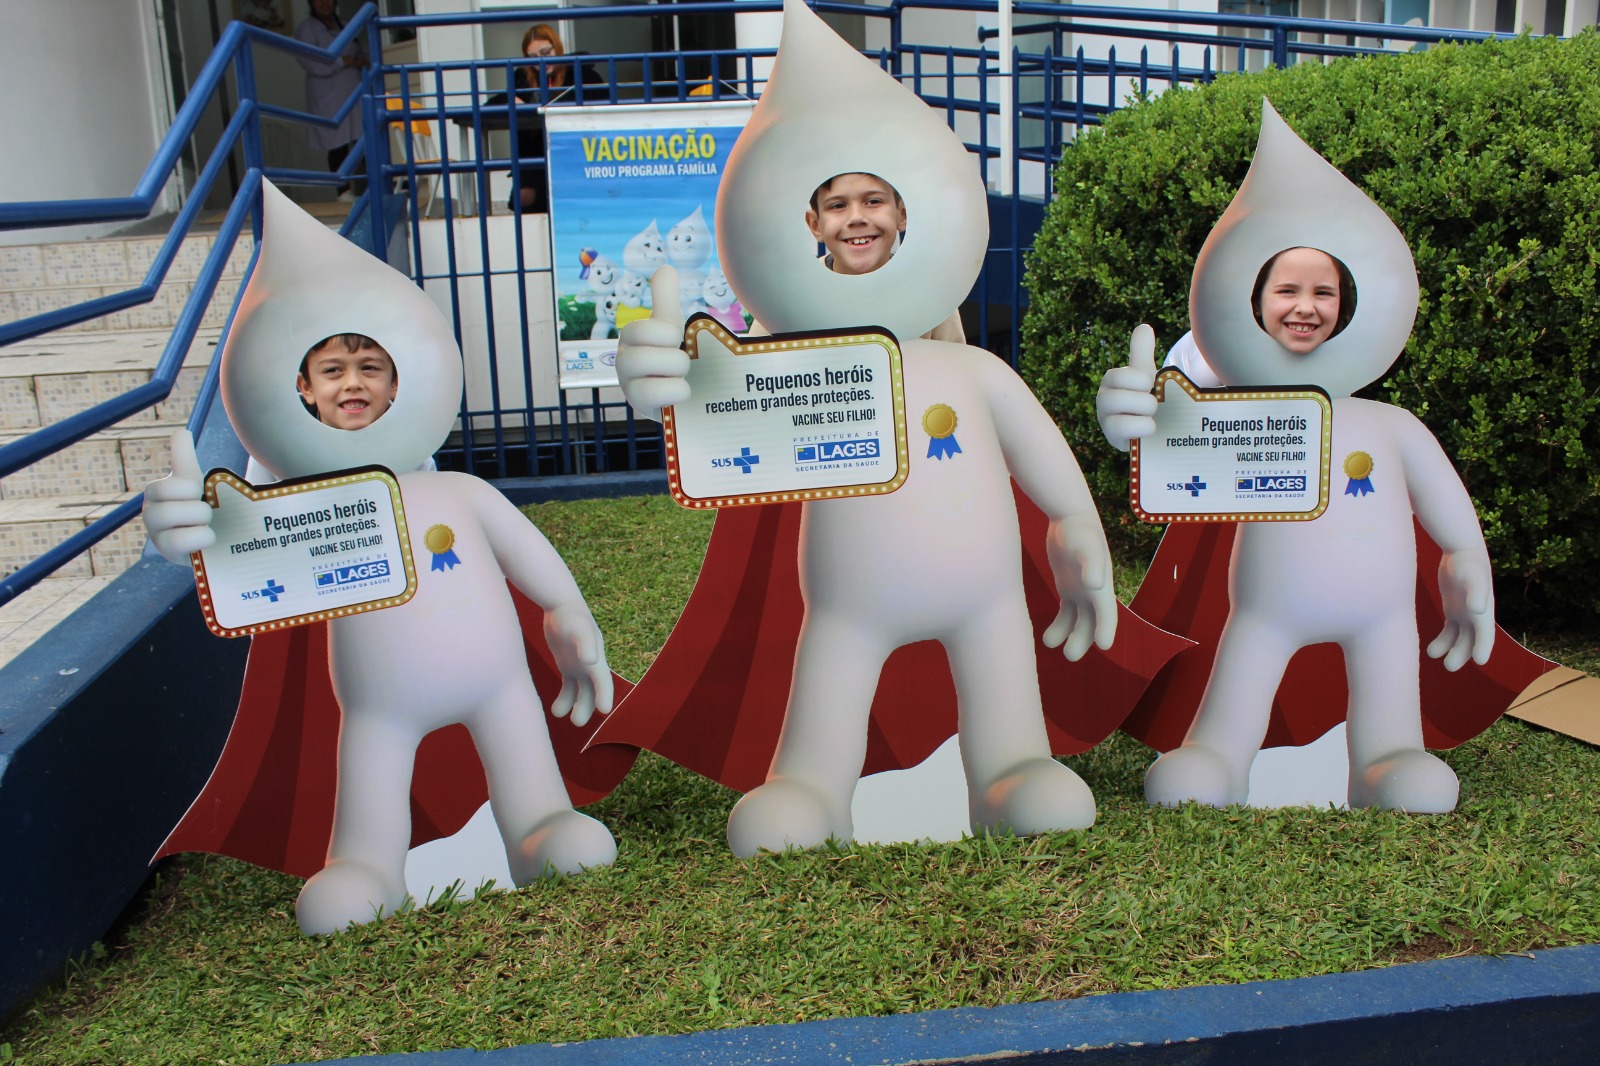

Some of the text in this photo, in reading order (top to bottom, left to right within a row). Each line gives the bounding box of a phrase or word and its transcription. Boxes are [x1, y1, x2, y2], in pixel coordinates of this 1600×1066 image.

[582, 129, 716, 163] VACINAÇÃO
[585, 161, 717, 178] VIROU PROGRAMA FAMÍLIA
[566, 362, 593, 370] LAGES
[745, 365, 873, 394] Pequenos heróis
[705, 388, 874, 413] recebem grandes proteções.
[792, 409, 876, 426] VACINE SEU FILHO!
[1201, 416, 1307, 434] Pequenos heróis
[793, 432, 860, 442] PREFEITURA
[1166, 434, 1306, 448] recebem grandes proteções.
[820, 442, 877, 460] LAGES
[1237, 452, 1306, 462] VACINE SEU FILHO!
[711, 458, 731, 468] SUS
[796, 464, 840, 472] SECRETARIA
[1256, 479, 1304, 490] LAGES
[264, 499, 377, 532] Pequenos heróis
[231, 519, 380, 554] recebem grandes proteções.
[310, 535, 383, 557] VACINE SEU FILHO!
[312, 556, 370, 571] PREFEITURA
[338, 562, 388, 582] LAGES
[241, 590, 260, 601] SUS
[318, 584, 357, 596] SECRETARIA
